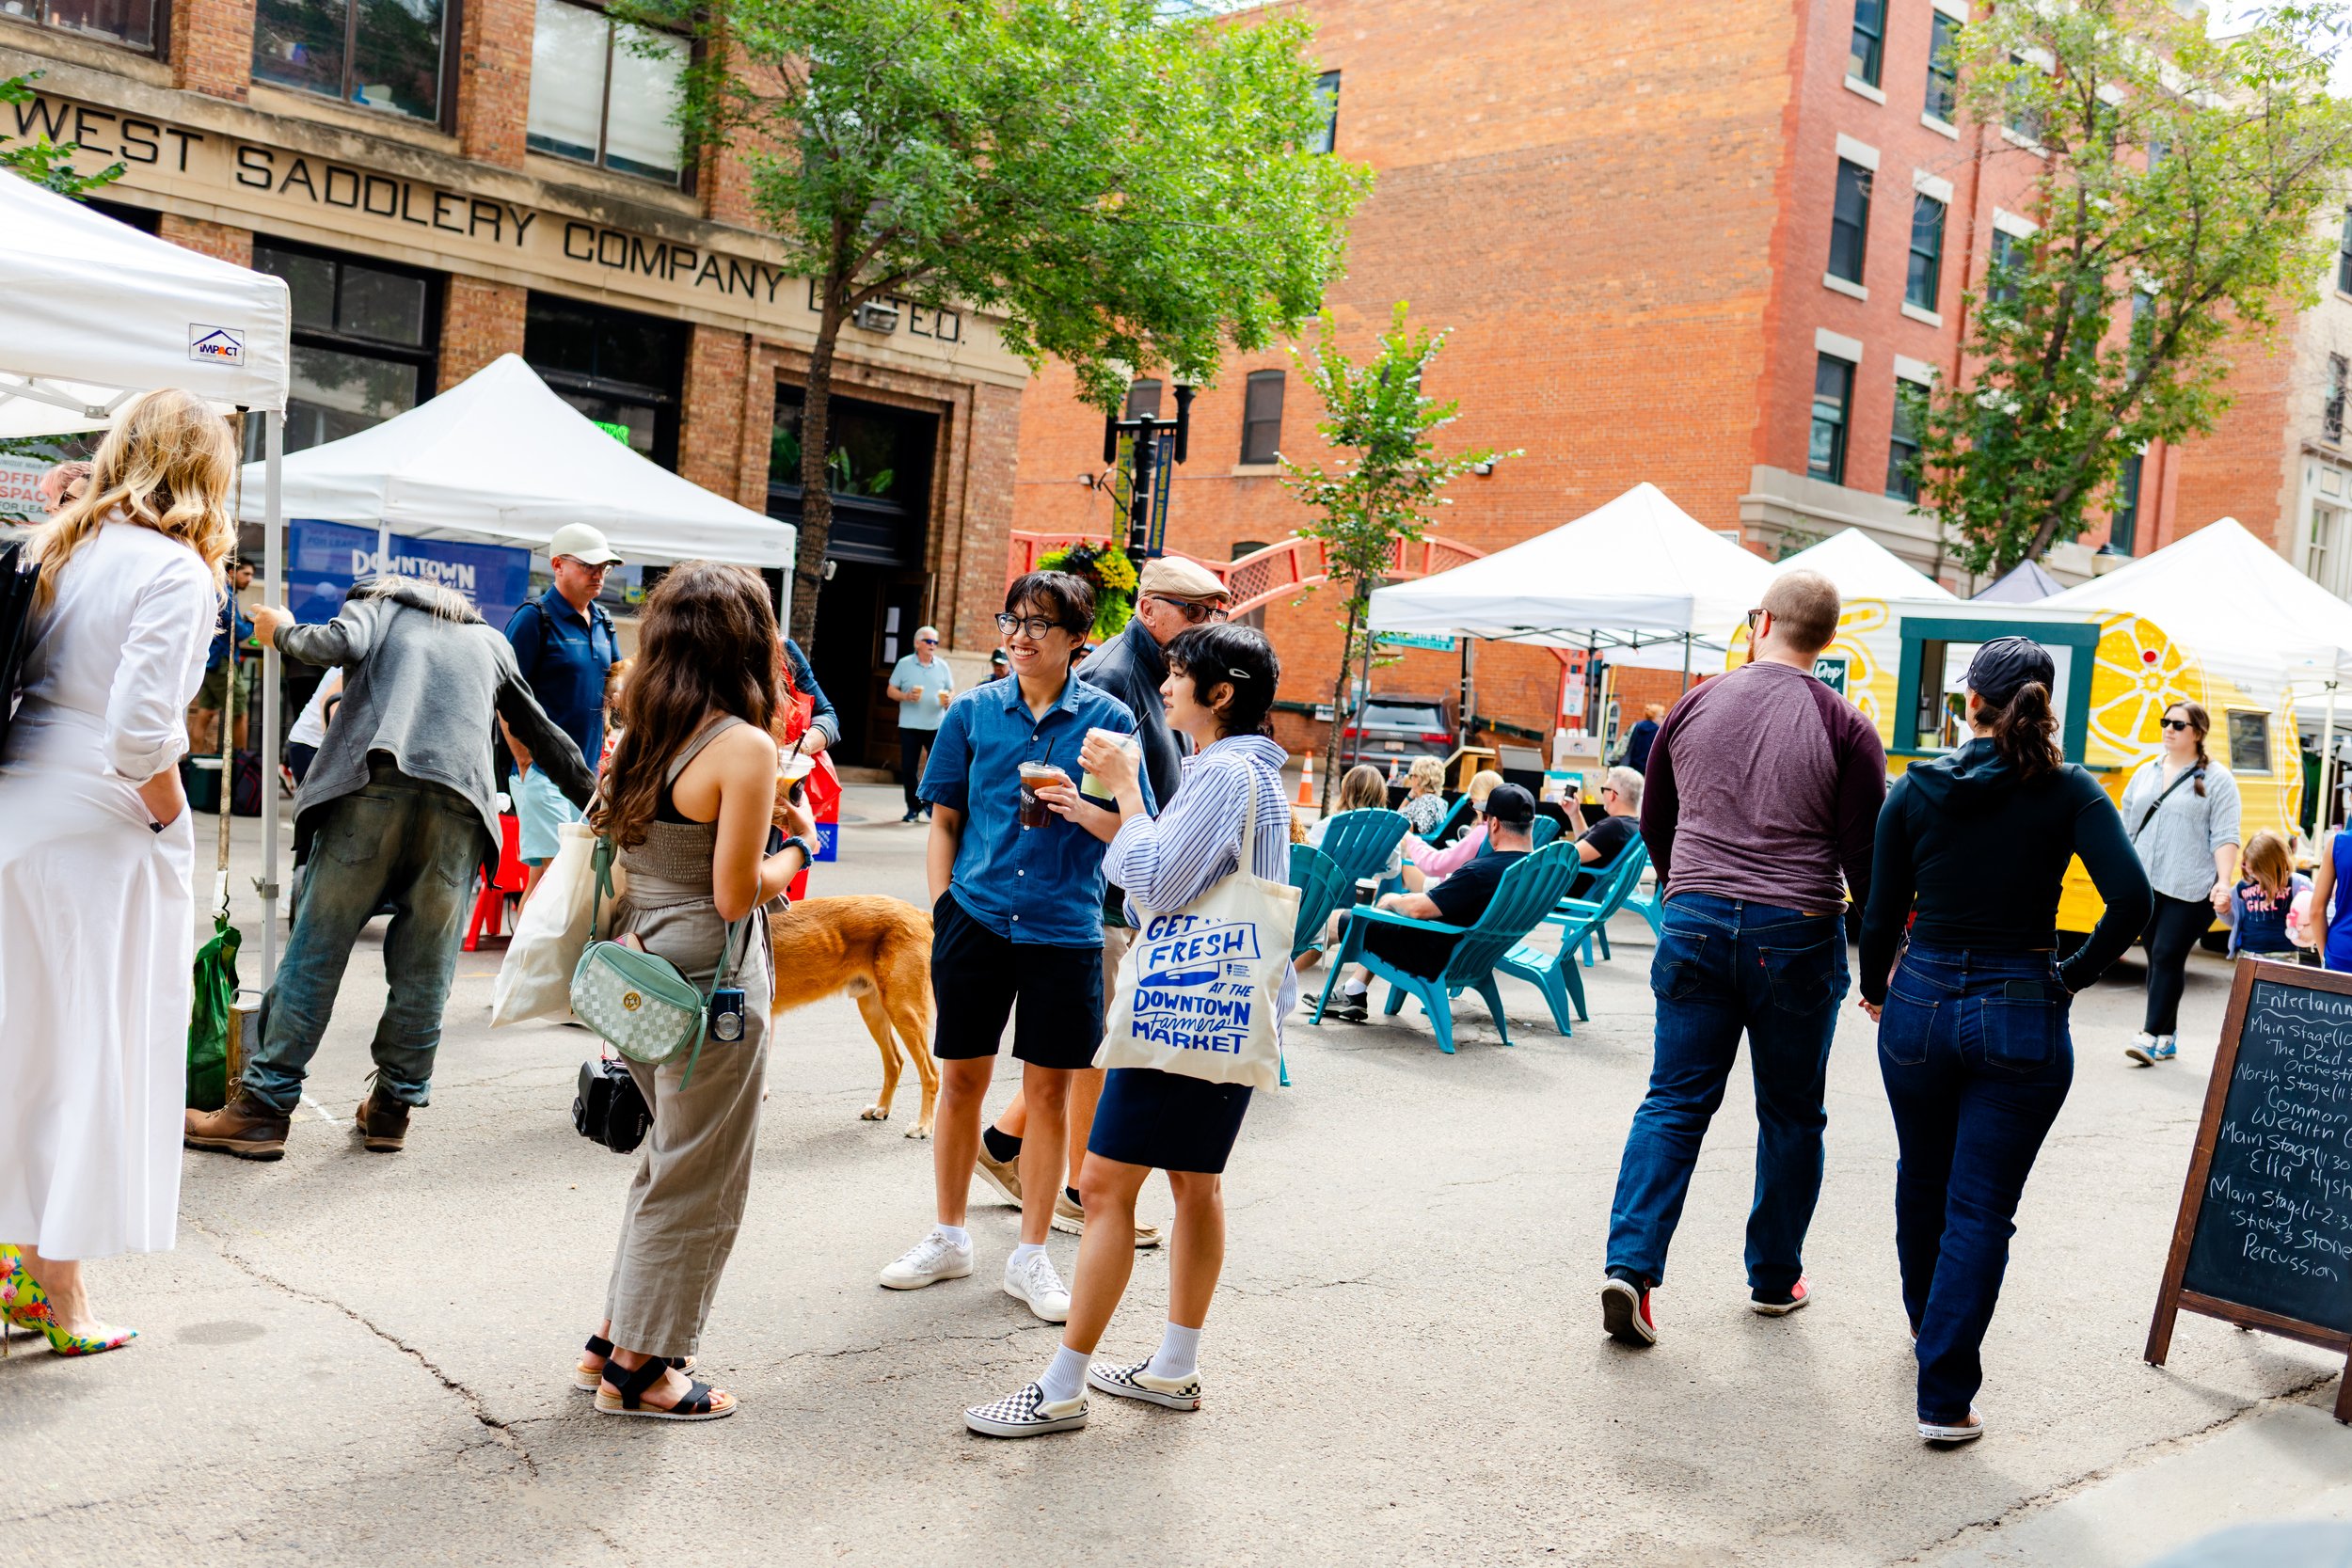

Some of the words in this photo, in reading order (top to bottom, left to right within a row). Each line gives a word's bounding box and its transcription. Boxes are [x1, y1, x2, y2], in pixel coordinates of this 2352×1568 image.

[12, 97, 203, 172] WEST
[237, 145, 536, 246] SADDLERY
[564, 221, 785, 303] COMPANY
[0, 485, 46, 502] SPAC
[2247, 899, 2279, 912] GIRL
[1146, 914, 1200, 942] GET
[1148, 929, 1245, 971] FRESH
[1208, 982, 1228, 993] AT
[1229, 984, 1255, 998] THE
[1133, 989, 1251, 1026] DOWNTOWN
[1131, 1021, 1248, 1054] MARKET
[2249, 1015, 2285, 1037] Main
[2303, 1043, 2343, 1066] Dead
[2234, 1063, 2280, 1084] North
[636, 1113, 646, 1136] Canon
[2220, 1120, 2263, 1148] Main
[2210, 1175, 2255, 1205] Main
[2242, 1232, 2339, 1282] Percussion
